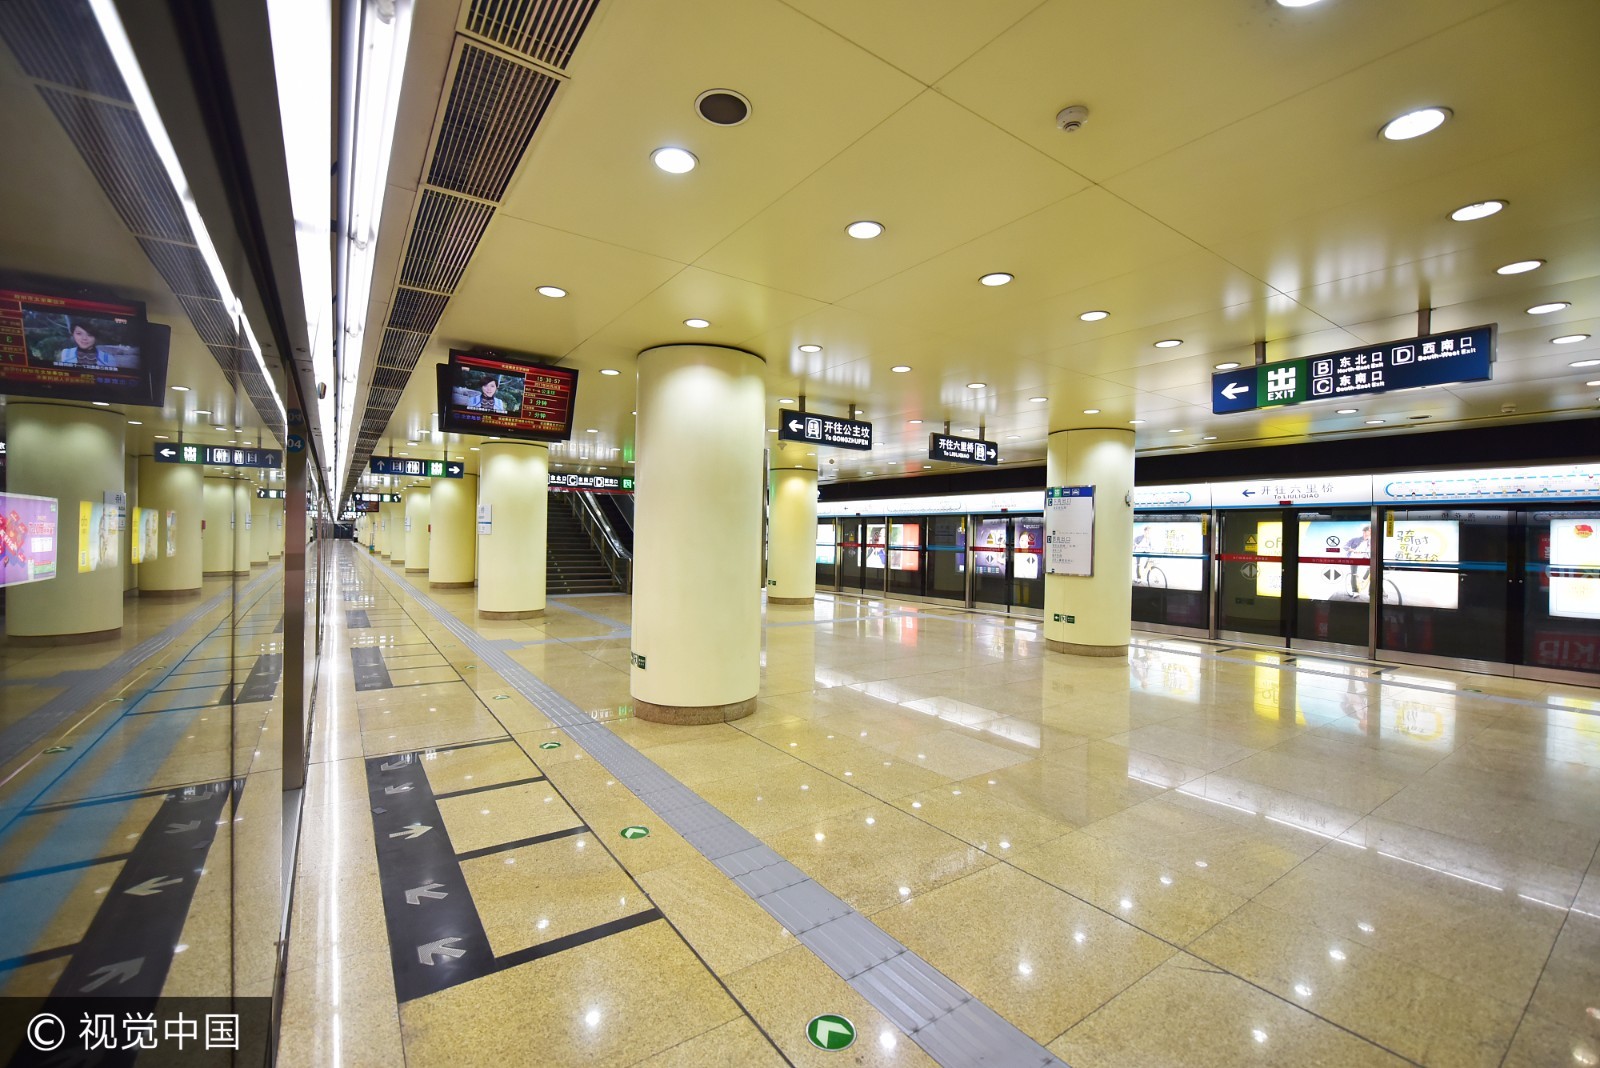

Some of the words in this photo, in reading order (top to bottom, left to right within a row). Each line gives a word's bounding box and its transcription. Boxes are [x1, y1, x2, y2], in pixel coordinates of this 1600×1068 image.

[1422, 337, 1472, 355] 西南口
[1461, 347, 1476, 355] Exit
[1339, 352, 1383, 368] 东北口
[1396, 349, 1411, 363] D
[1317, 362, 1330, 375] B
[1337, 364, 1370, 374] North-East
[1339, 371, 1383, 386] 东南口
[1316, 379, 1330, 393] C
[1267, 389, 1296, 402] EXIT
[824, 421, 870, 438] 开往公主坟
[287, 438, 302, 449] 04
[938, 438, 974, 453] 开往六里桥
[1260, 482, 1334, 496] 开往六里桥
